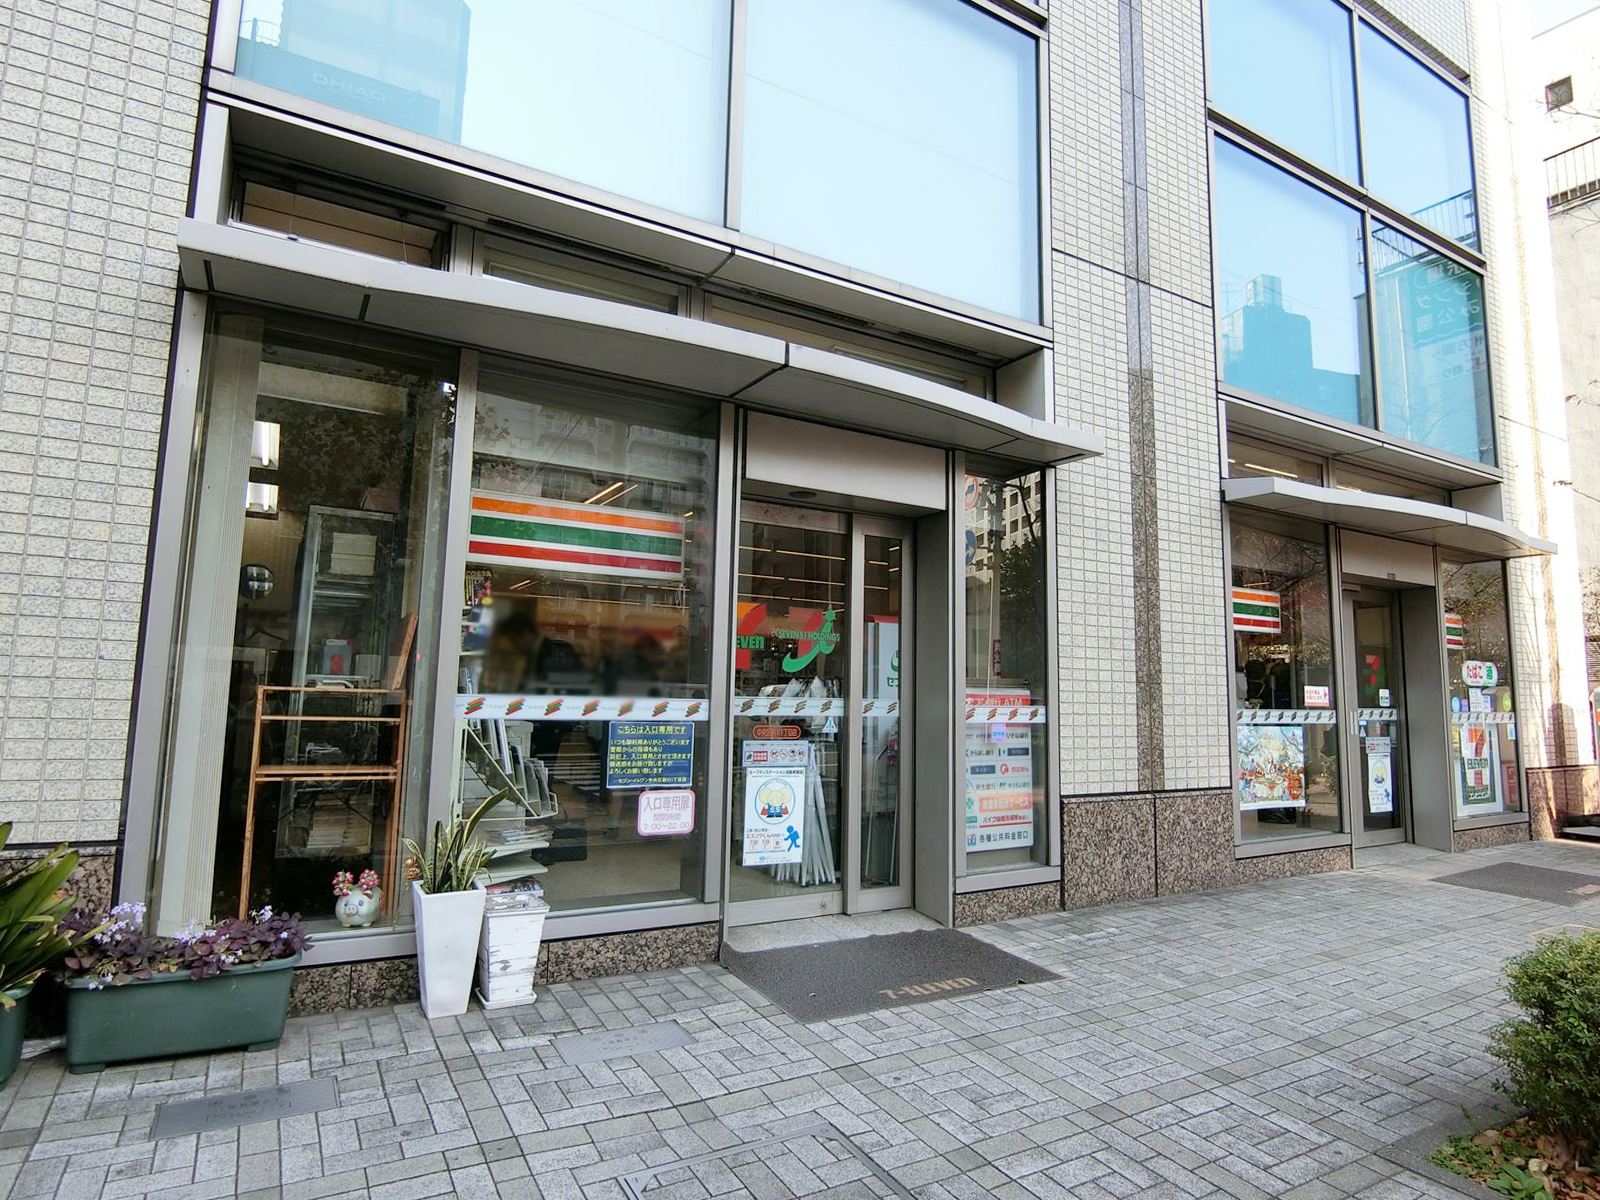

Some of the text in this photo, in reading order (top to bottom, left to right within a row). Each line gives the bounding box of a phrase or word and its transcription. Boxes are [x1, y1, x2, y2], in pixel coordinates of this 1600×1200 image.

[1004, 698, 1022, 706] ATM
[618, 726, 687, 734] こちらは入口専用です
[643, 795, 690, 811] 入口専用扉
[980, 830, 1029, 843] 各種公共料金窓口
